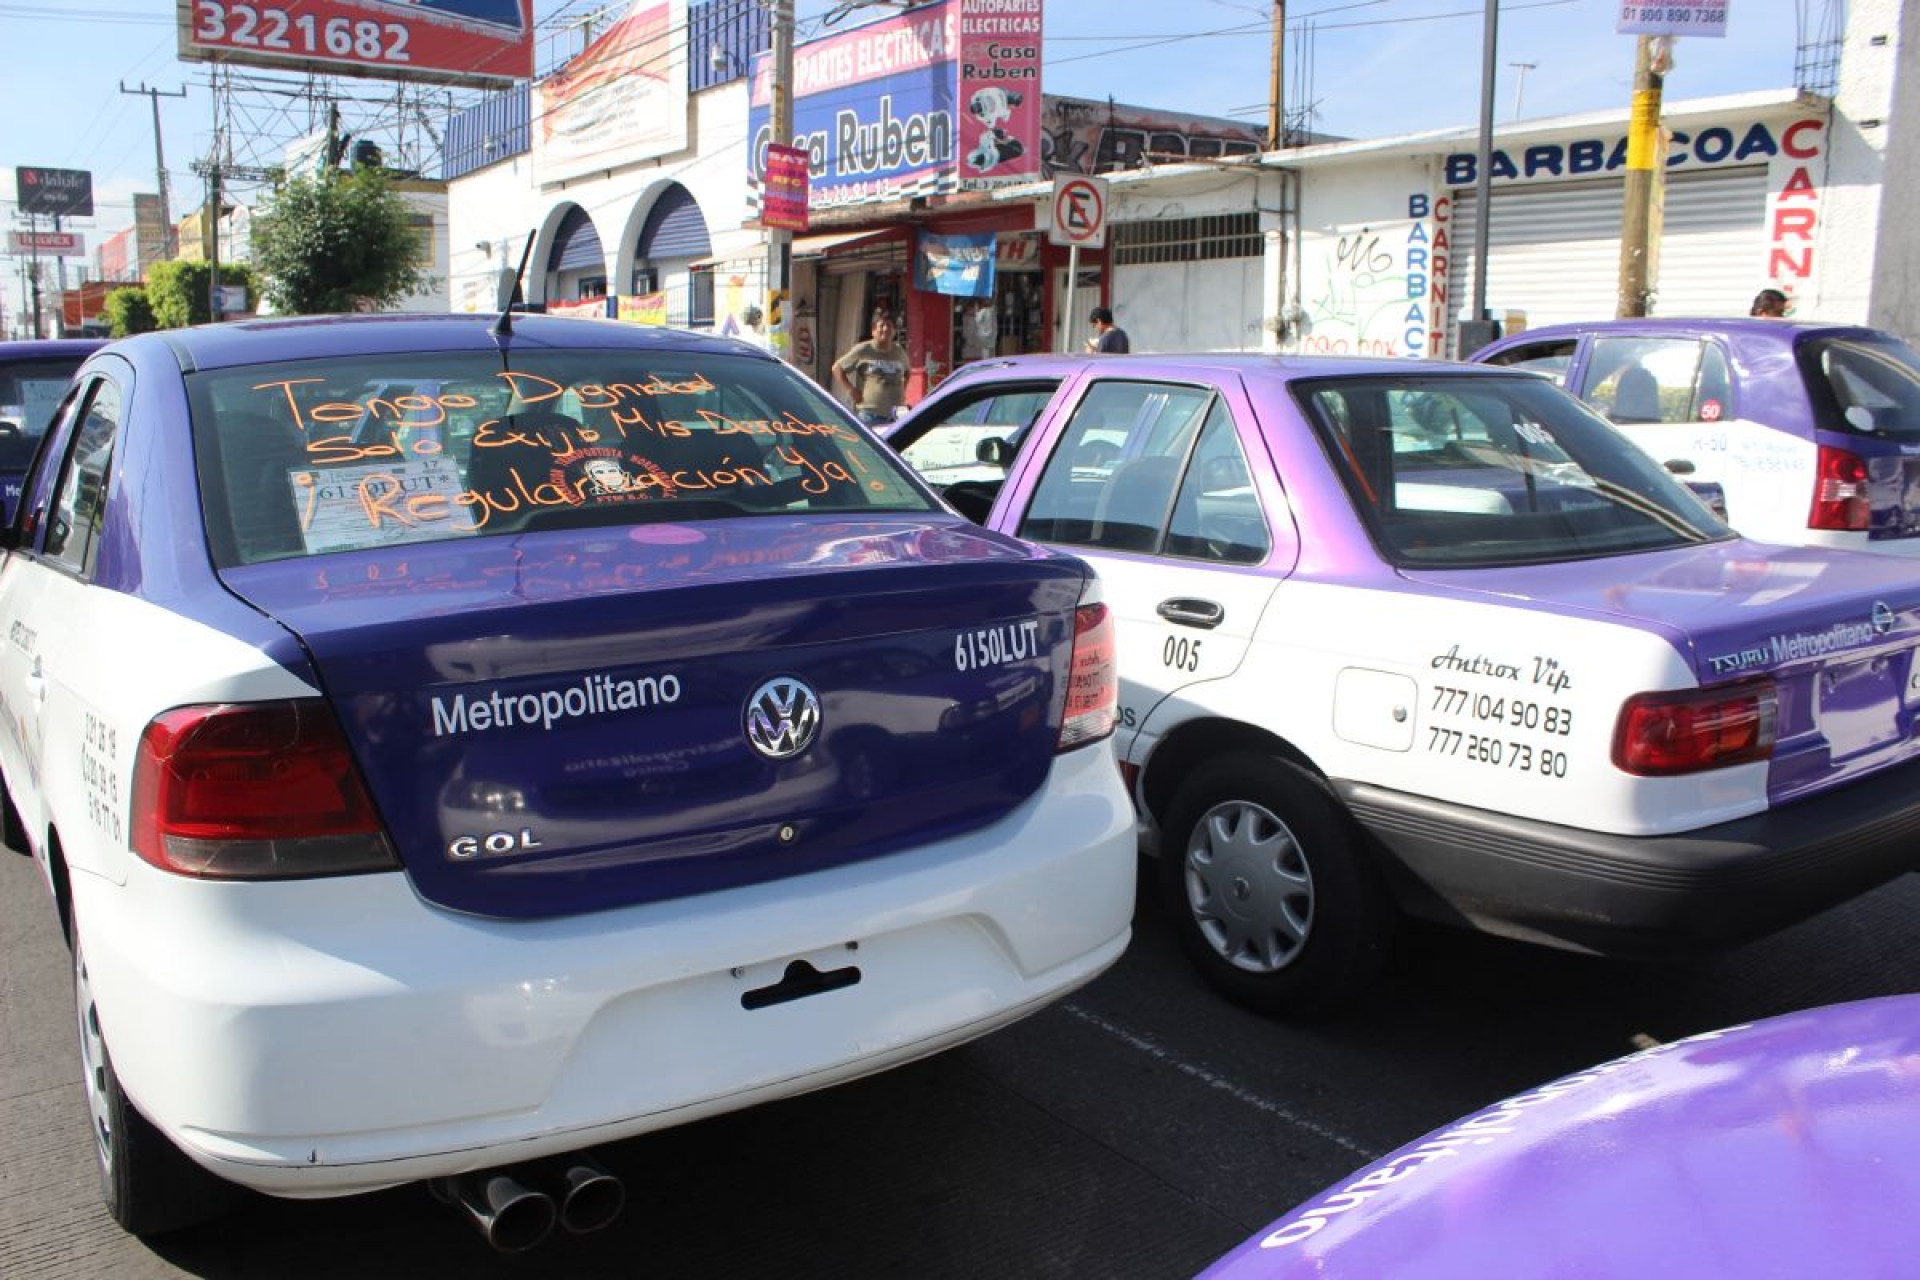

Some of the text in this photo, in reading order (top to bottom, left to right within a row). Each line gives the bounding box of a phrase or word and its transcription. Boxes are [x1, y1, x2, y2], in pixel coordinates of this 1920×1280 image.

[197, 0, 411, 62] 3221682
[962, 0, 1040, 14] AUTOPARTES
[962, 17, 1040, 34] ELECTRICAS
[1695, 9, 1726, 23] 7368
[857, 14, 956, 76] ELECTRICAS
[988, 44, 1036, 59] Casa
[963, 63, 1036, 79] Ruben
[754, 94, 952, 184] Ca Ruben
[1405, 194, 1429, 358] BARBAC
[1702, 404, 1720, 419] 50
[306, 431, 442, 463] Solo
[955, 621, 1038, 671] 6150LUT
[1163, 635, 1202, 672] 005
[1431, 644, 1571, 694] Antrox Vip
[1709, 623, 1873, 673] TSURU Metropolitano
[431, 674, 681, 737] Metropolitano
[1432, 686, 1572, 736] 777 104 90 83
[1428, 726, 1567, 778] 777 260 73 80
[450, 828, 542, 857] GOL
